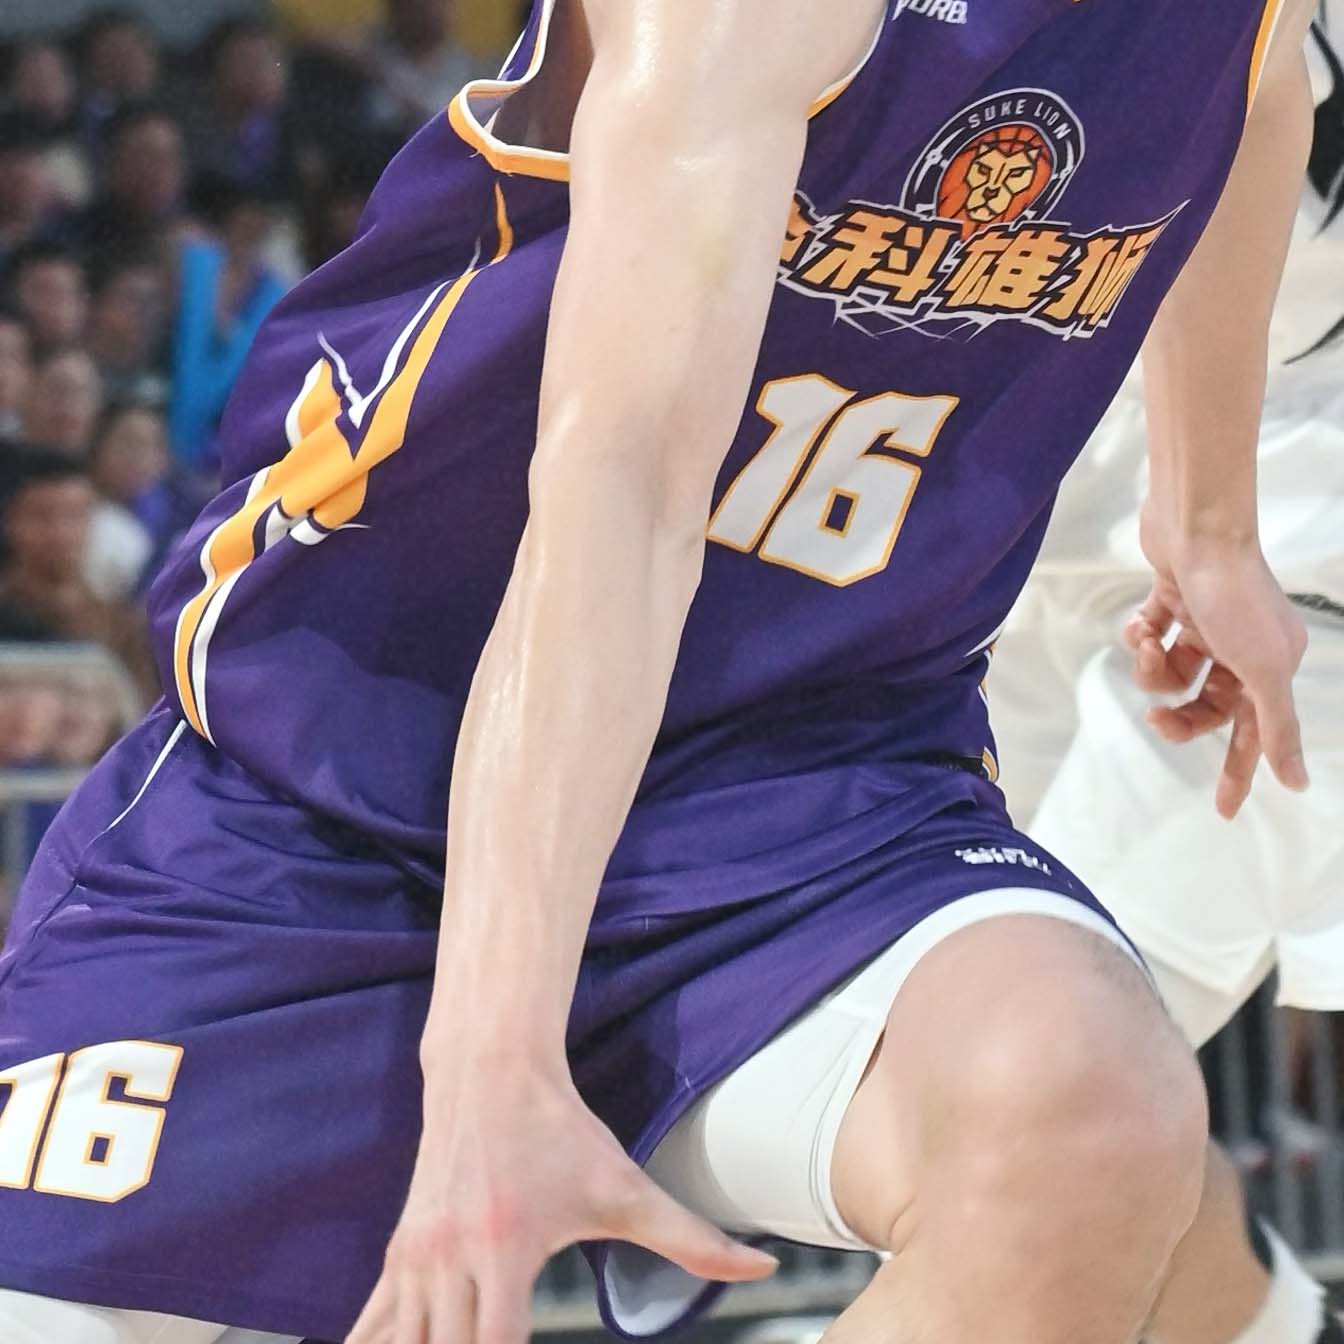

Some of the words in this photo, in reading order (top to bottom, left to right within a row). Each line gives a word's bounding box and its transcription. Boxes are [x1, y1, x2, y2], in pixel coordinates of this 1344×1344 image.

[967, 99, 1027, 129] SUKE
[1034, 102, 1072, 140] LION
[706, 373, 960, 587] 16
